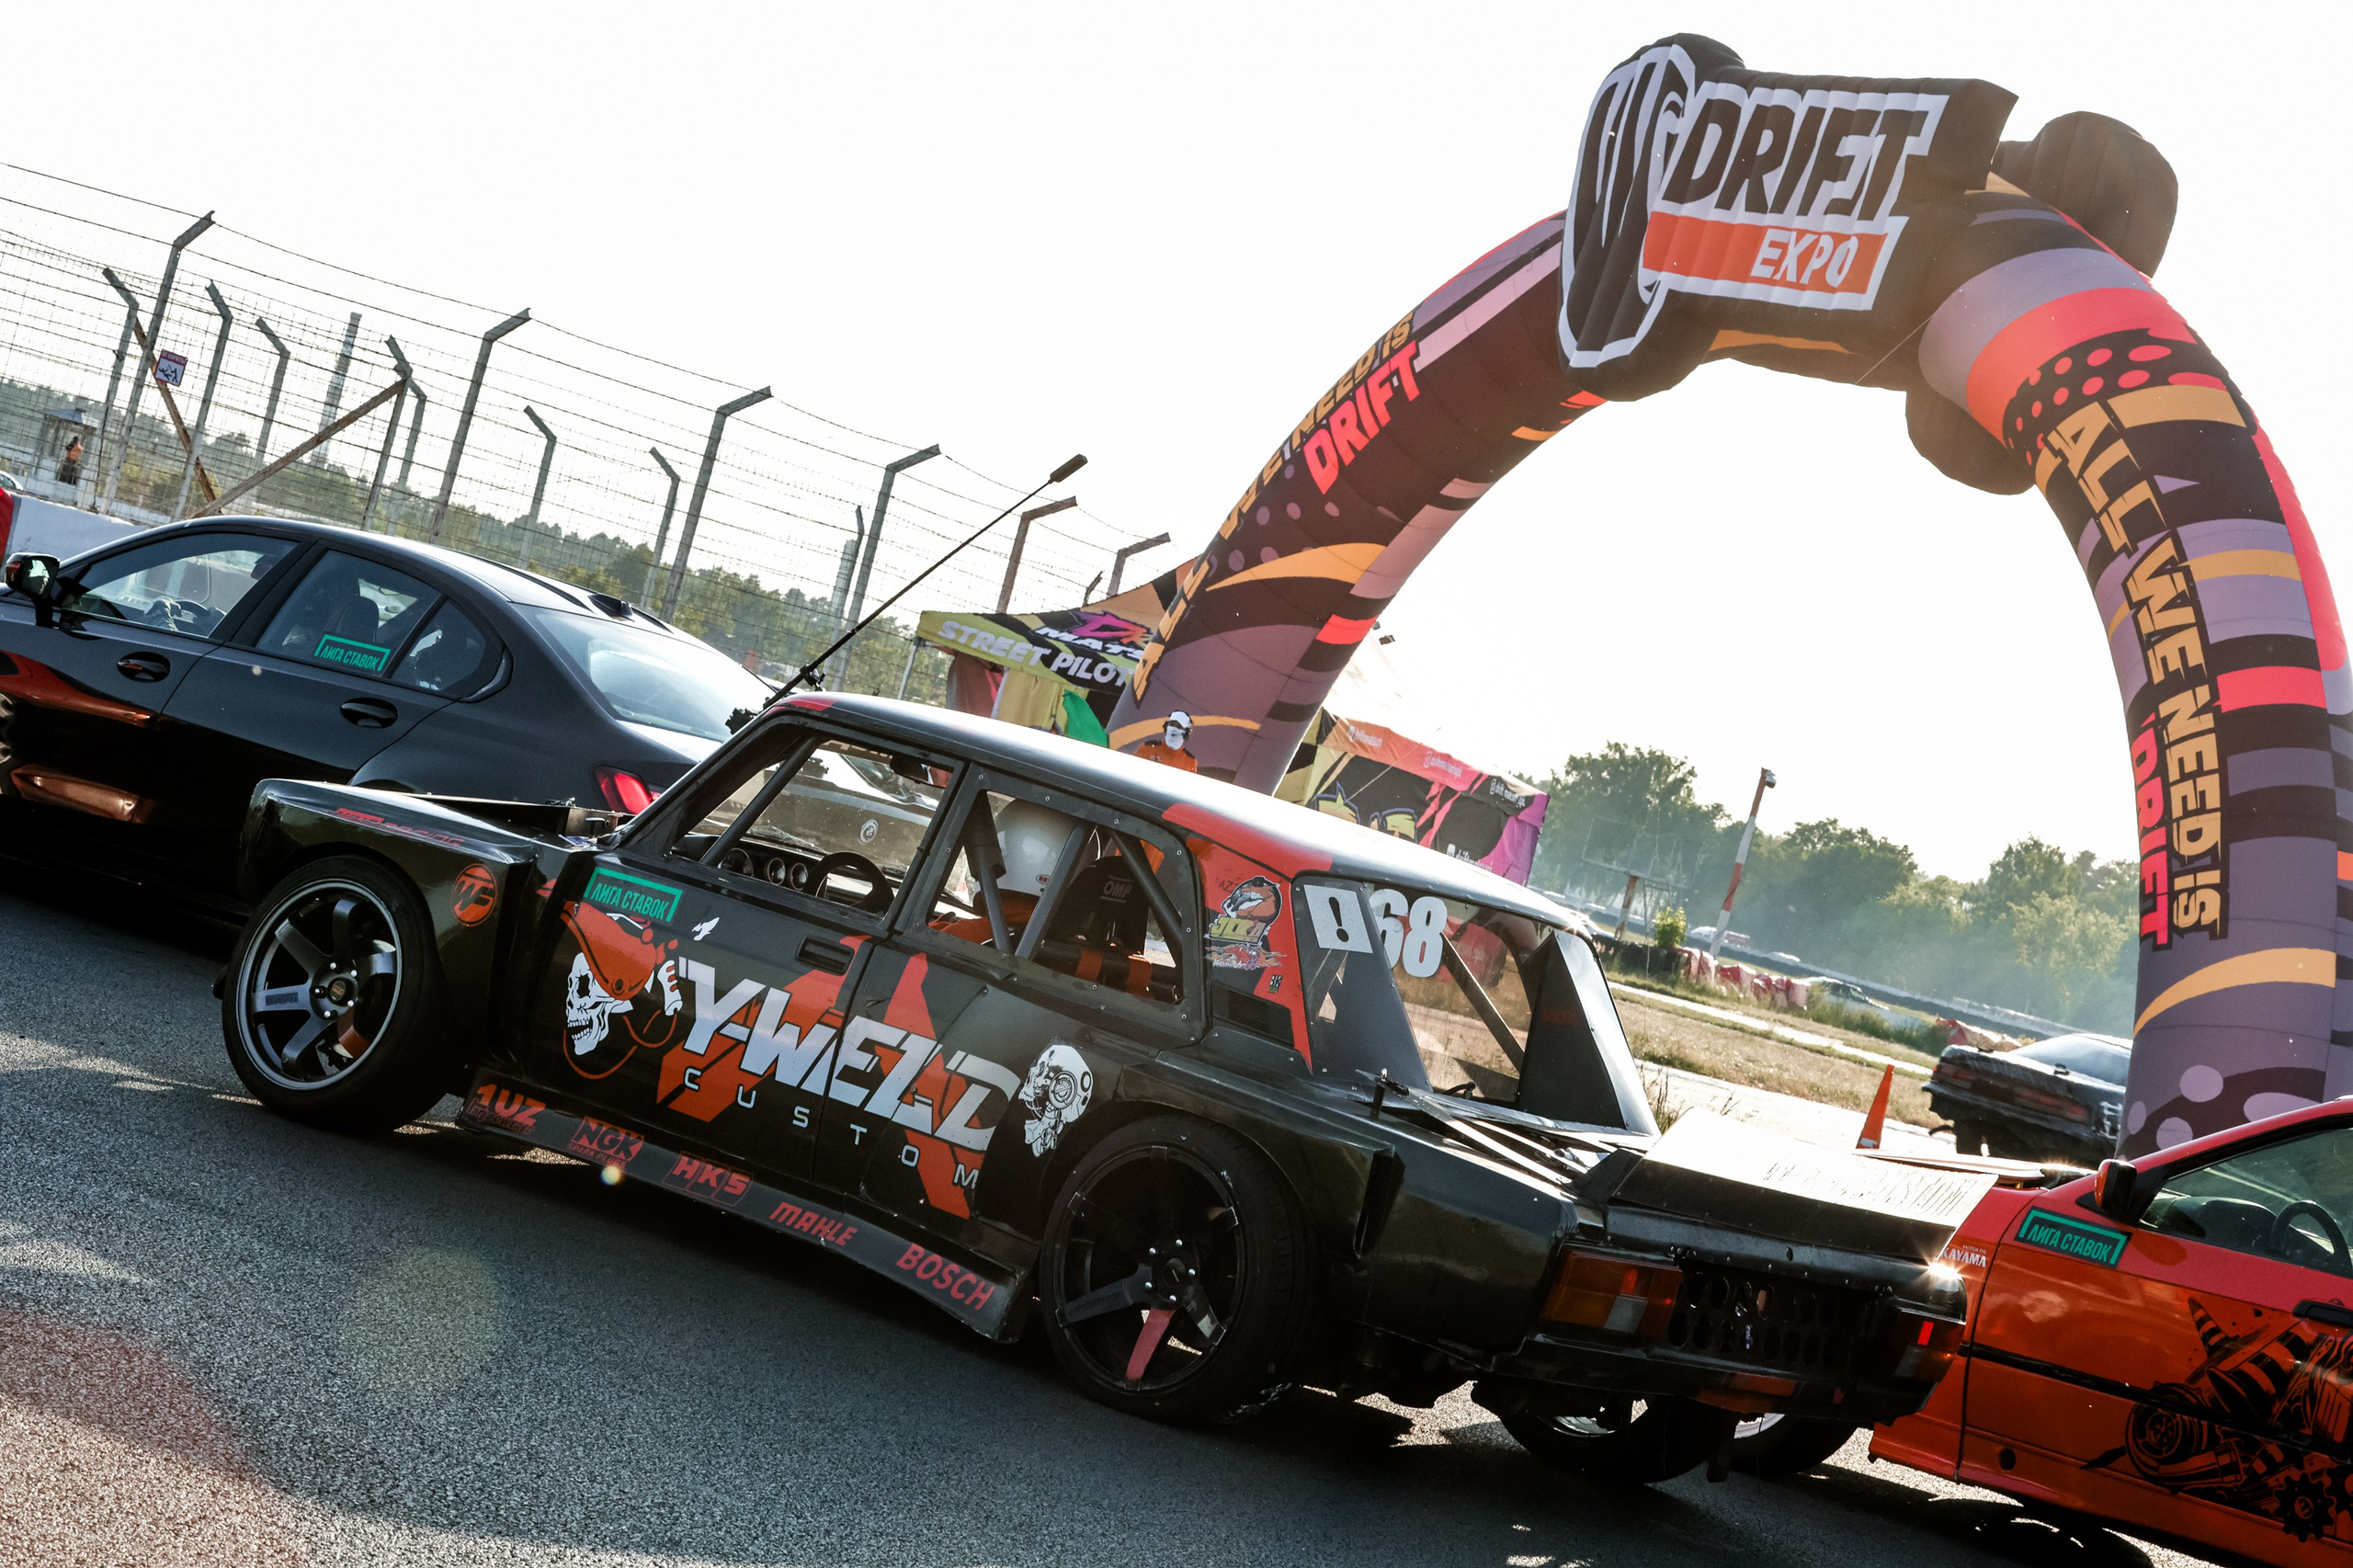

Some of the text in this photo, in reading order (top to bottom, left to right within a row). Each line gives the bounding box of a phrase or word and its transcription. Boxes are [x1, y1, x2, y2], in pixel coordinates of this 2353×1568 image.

[1660, 97, 1931, 222] DRIFT
[1749, 227, 1860, 289] EXPO
[1291, 343, 1379, 450] NEED
[1382, 311, 1415, 360] IS
[1302, 339, 1419, 495] DRIFT
[319, 645, 381, 671] ЛИГА СТАВОК
[938, 620, 1052, 666] STREET
[2047, 401, 2222, 938] ALL WE NEED IS
[2130, 722, 2169, 946] DRIFT
[590, 882, 670, 920] ЛИГА СТАВОК
[1103, 880, 1133, 899] OMP
[476, 1083, 547, 1127] 1UZ
[684, 1067, 980, 1189] CUSTOM
[566, 1142, 629, 1171] SPARK PLUGS
[571, 1116, 644, 1162] NGK
[672, 1155, 751, 1196] HKS
[768, 1200, 858, 1246] MAHLE
[2027, 1223, 2113, 1263] ЛИГА СТАВОК
[1962, 1244, 1979, 1253] MOTOR
[895, 1242, 996, 1312] BOSCH
